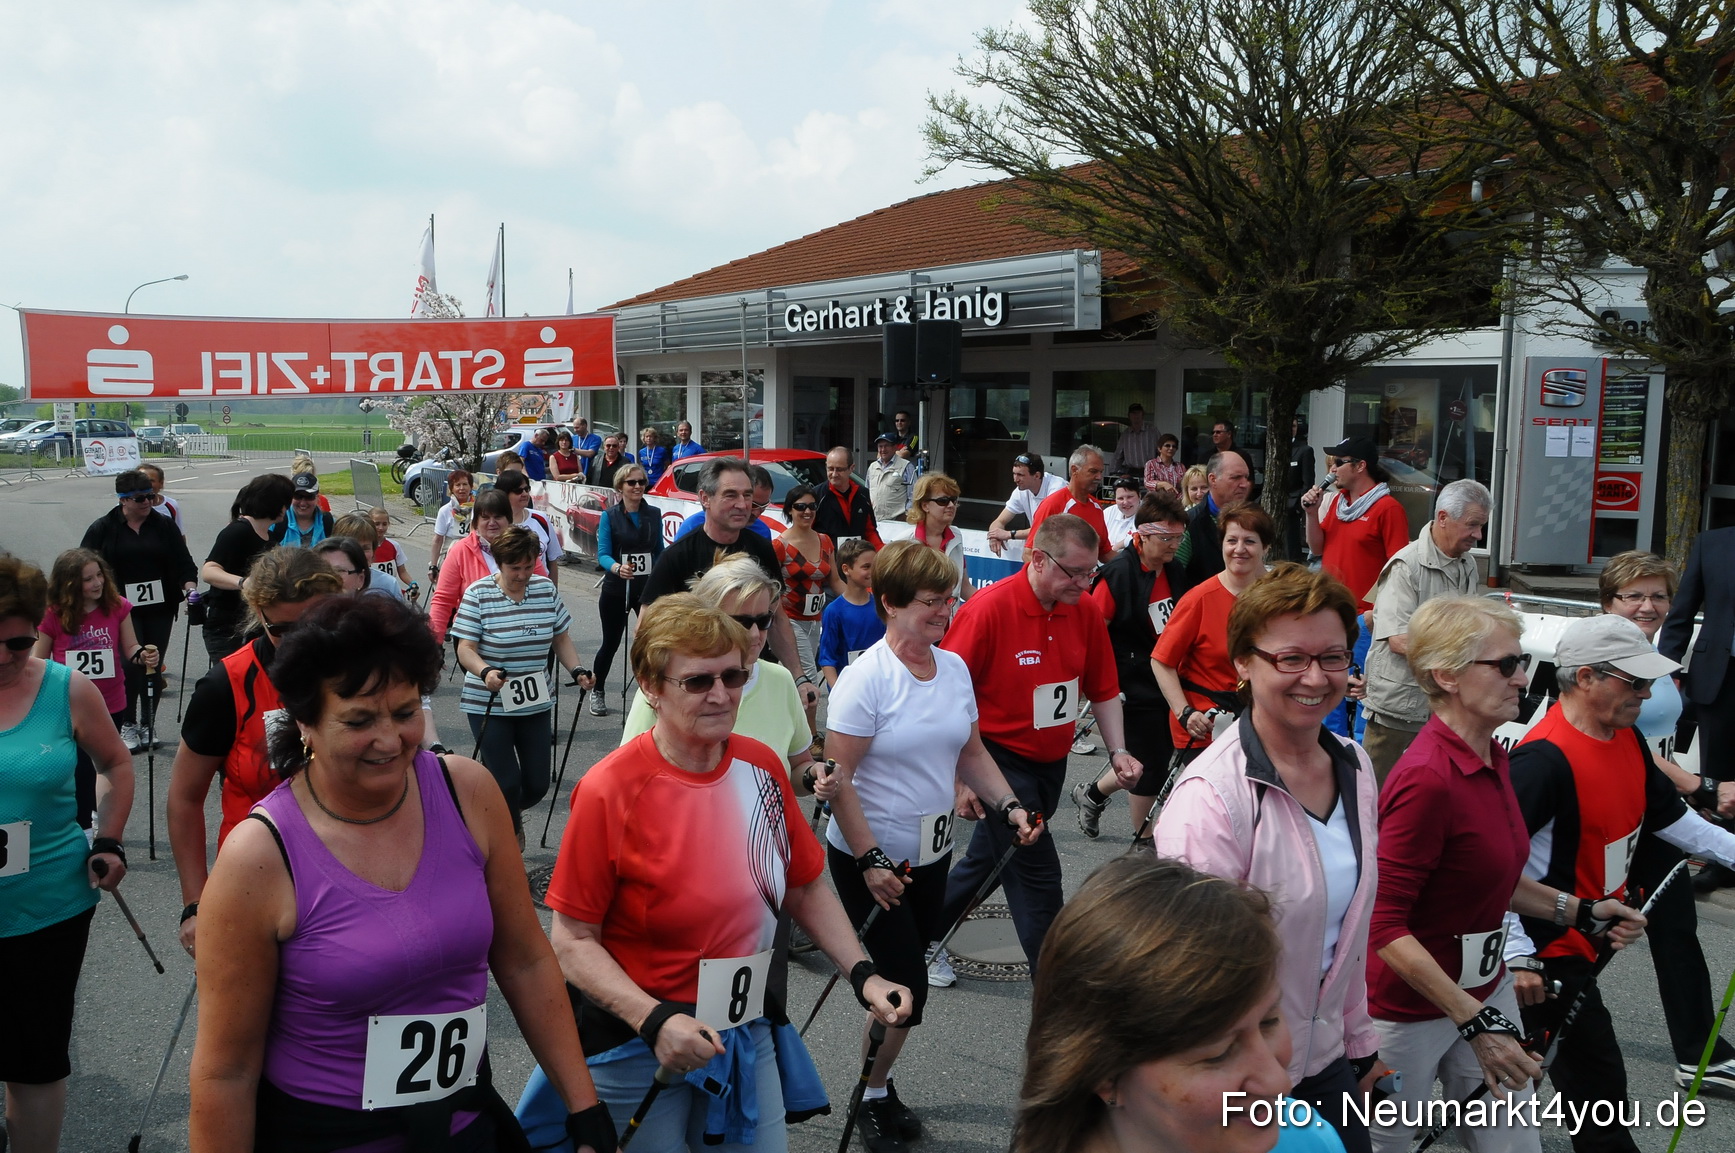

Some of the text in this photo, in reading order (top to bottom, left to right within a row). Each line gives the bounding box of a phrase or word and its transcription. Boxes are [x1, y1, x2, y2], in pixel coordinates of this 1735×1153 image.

[784, 284, 1004, 332] Gerhart & Jänig
[1532, 417, 1592, 426] SEAT
[459, 522, 471, 535] 34
[378, 562, 393, 576] 36
[136, 583, 154, 603] 21
[77, 651, 104, 676] 25
[1018, 656, 1041, 666] RBA
[510, 676, 539, 706] 30
[1053, 685, 1068, 721] 2
[932, 809, 955, 854] 82
[728, 966, 753, 1024] 8
[396, 1017, 469, 1095] 26
